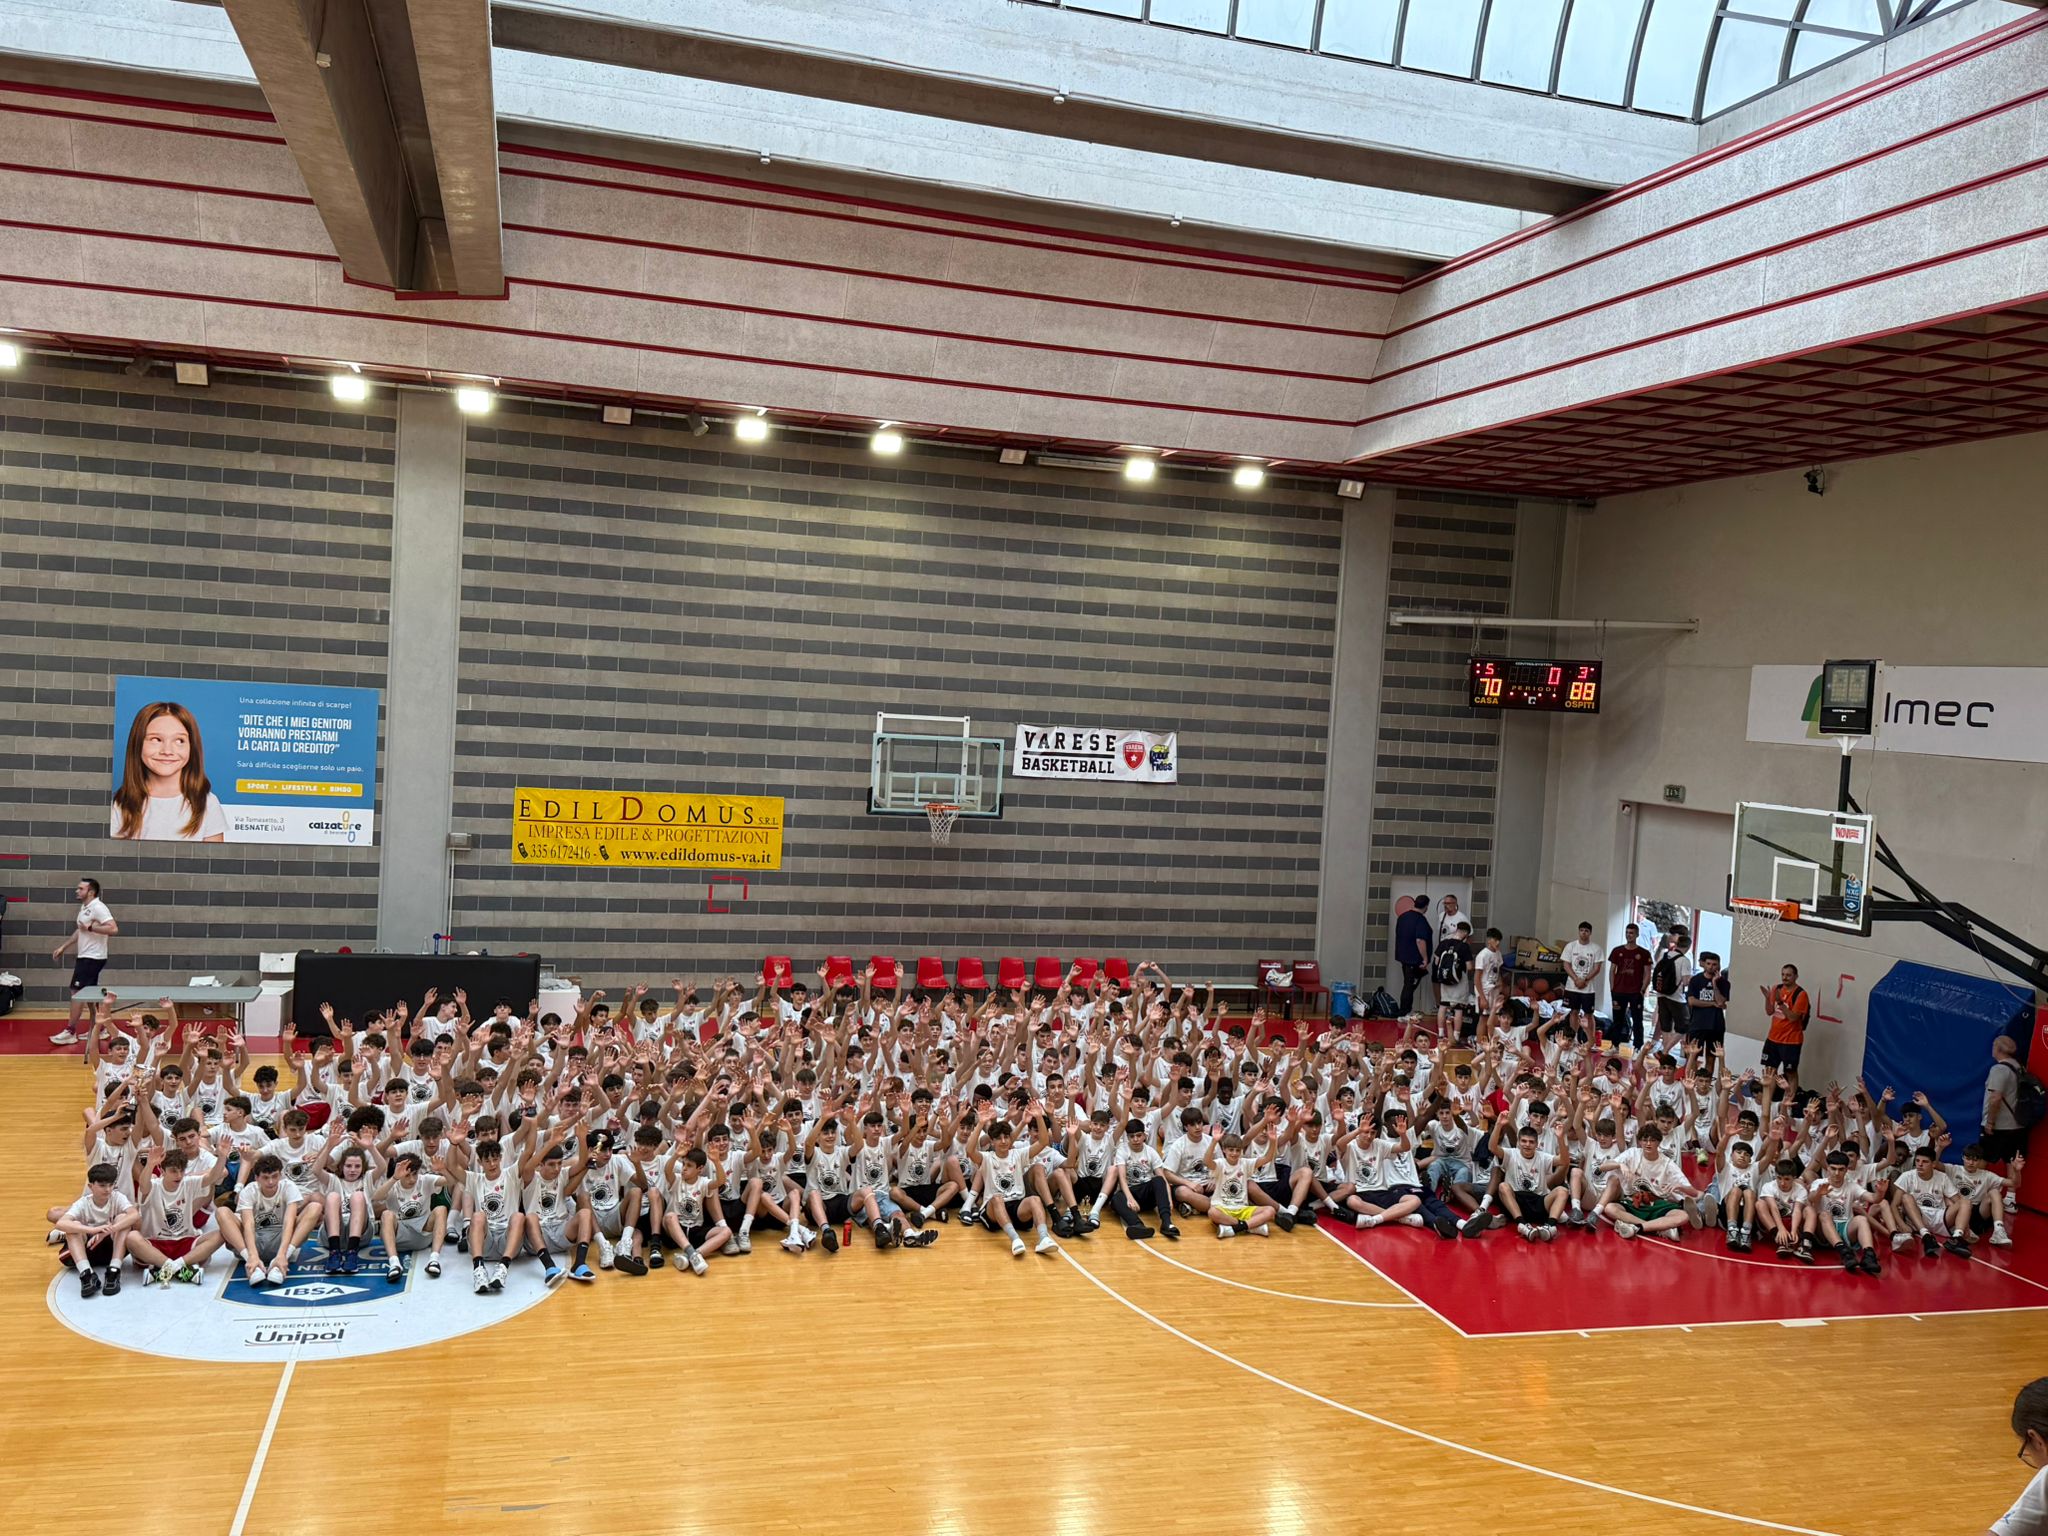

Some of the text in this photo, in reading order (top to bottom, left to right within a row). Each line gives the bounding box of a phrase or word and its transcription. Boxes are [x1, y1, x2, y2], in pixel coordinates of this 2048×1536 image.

[1485, 663, 1494, 675] 5
[1578, 667, 1588, 679] 3
[1479, 678, 1502, 696] 70
[1569, 682, 1596, 700] 88
[255, 698, 290, 706] collezione
[292, 699, 316, 707] infinita
[1565, 701, 1595, 709] OSPITI
[265, 716, 283, 727] CHE
[290, 717, 310, 728] MIEI
[311, 718, 352, 730] GENITORI
[238, 727, 338, 742] VORRANNO PRESTARMI
[237, 740, 249, 751] LA
[251, 741, 280, 752] CARTA
[282, 742, 291, 752] DI
[1024, 731, 1117, 752] VARESE
[237, 760, 254, 768] Sarà
[255, 761, 280, 769] difficile
[282, 763, 319, 771] sceglierne
[1021, 757, 1115, 774] BASKETBALL
[281, 784, 318, 792] LIFESTYLE
[270, 824, 285, 832] (VA)
[309, 822, 362, 831] calzature
[528, 825, 769, 845] IMPRESA EDILE & PROGETTAZIONI
[530, 844, 547, 859] 335
[550, 845, 591, 860] 6172416
[620, 847, 771, 865] www.edildomus-va.it
[284, 1287, 345, 1296] IBSA
[254, 1329, 344, 1344] Unipol
